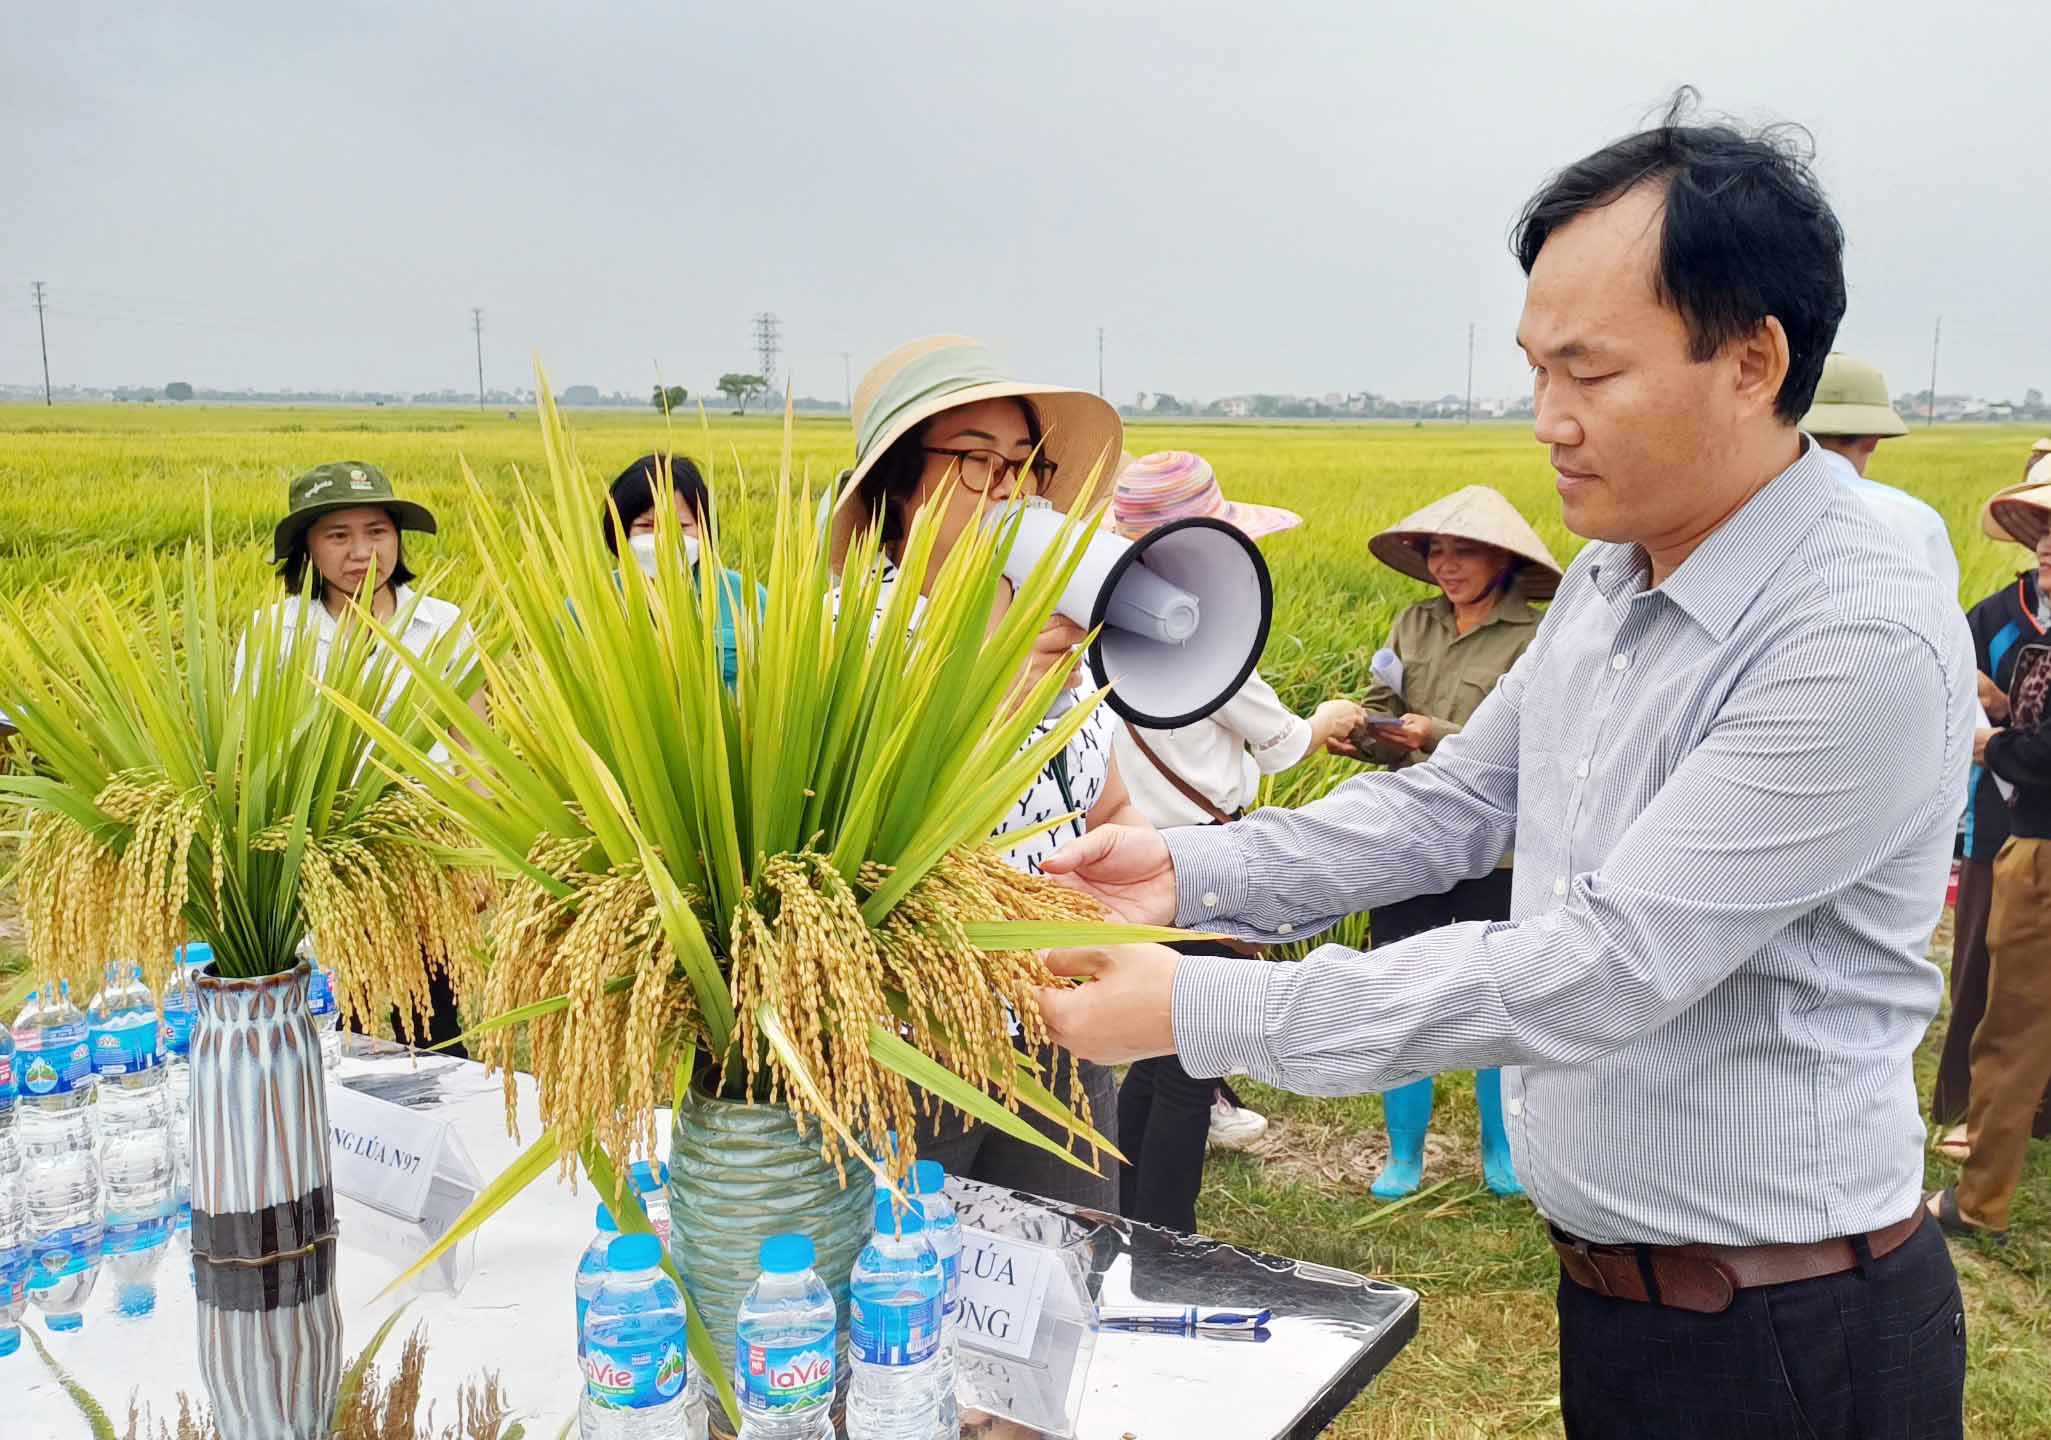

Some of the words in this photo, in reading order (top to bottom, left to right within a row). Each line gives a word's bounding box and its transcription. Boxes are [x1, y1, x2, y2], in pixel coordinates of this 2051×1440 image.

[328, 1120, 354, 1150] NG
[355, 1136, 385, 1163] LÚA
[389, 1148, 420, 1175] N97
[960, 1243, 1016, 1286] LÚA
[769, 1359, 831, 1388] laVie
